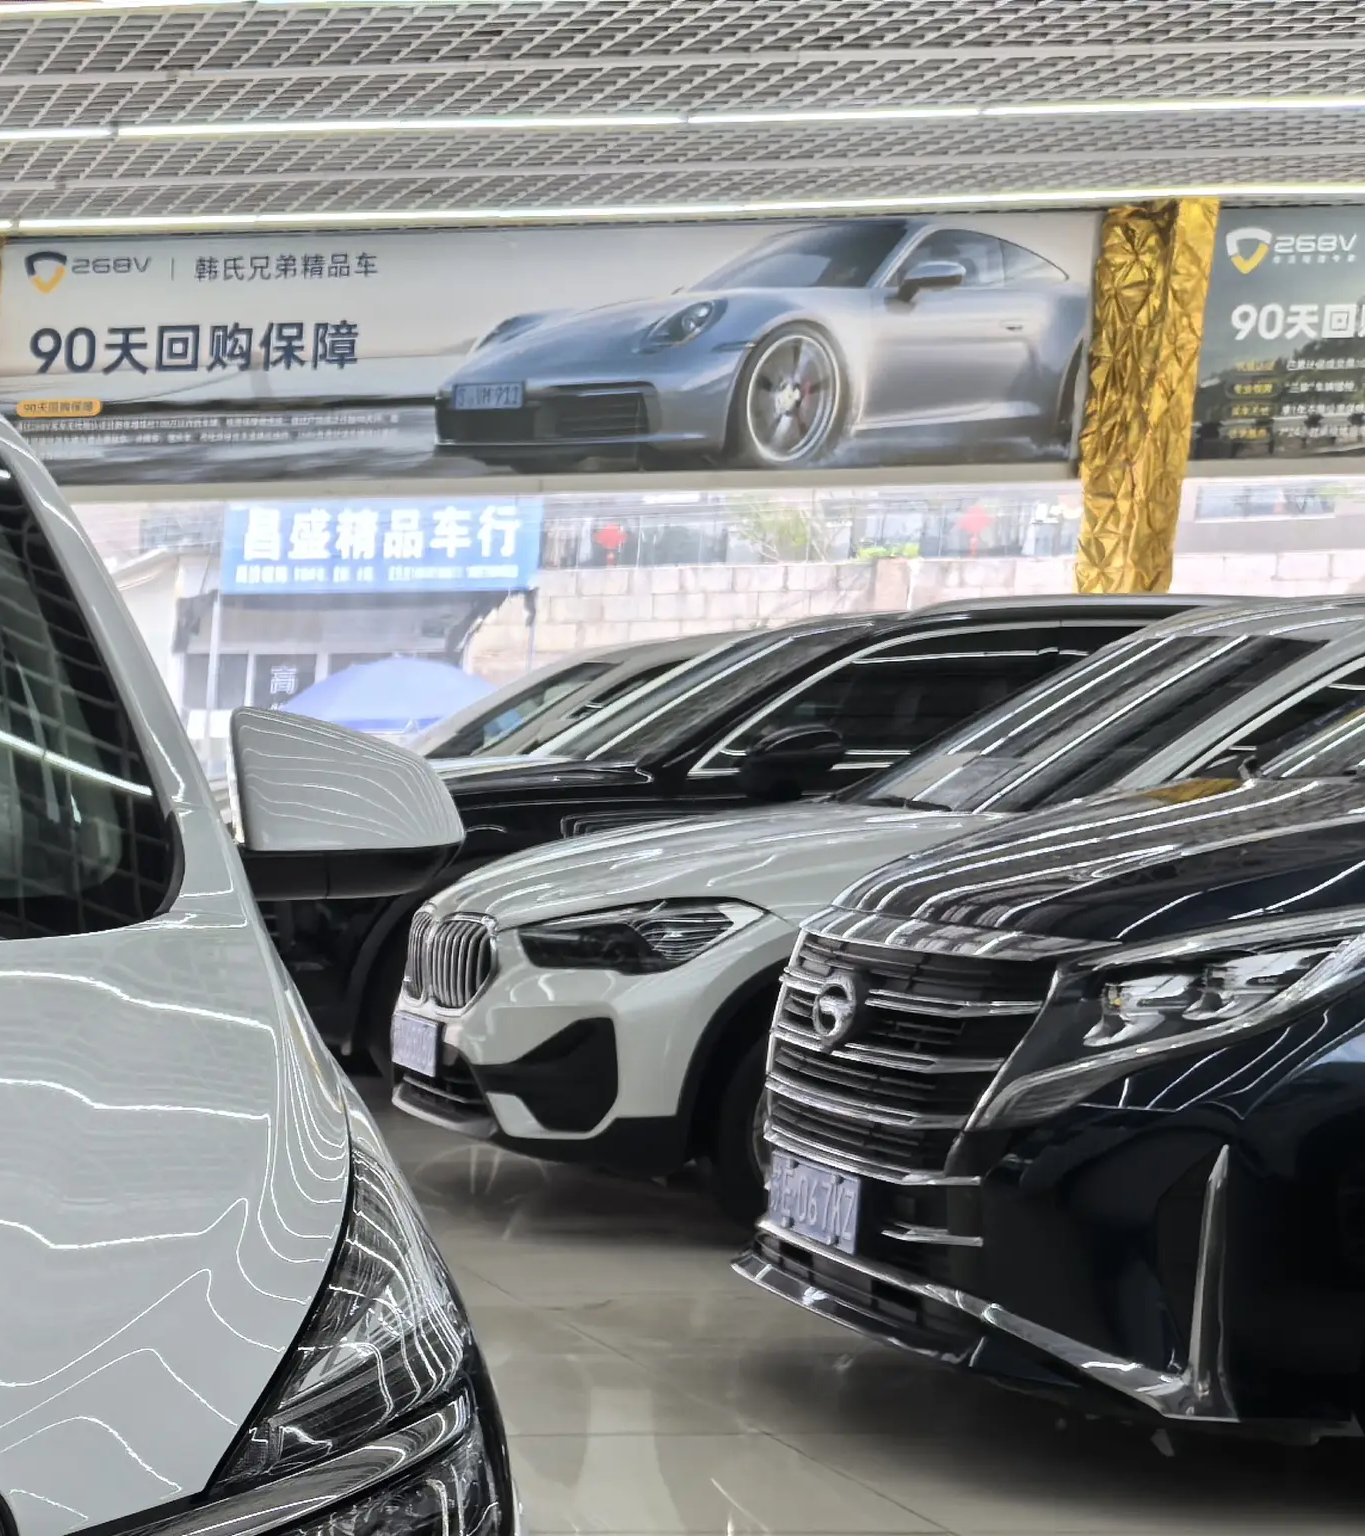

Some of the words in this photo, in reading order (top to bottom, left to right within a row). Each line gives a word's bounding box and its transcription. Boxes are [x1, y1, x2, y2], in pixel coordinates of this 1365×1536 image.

[1273, 233, 1358, 254] 268V
[71, 256, 152, 275] 268V
[193, 251, 379, 282] 韩氏兄弟精品车
[1230, 303, 1365, 341] 90天回
[29, 318, 360, 376] 90天回购保障
[242, 505, 520, 561] 昌盛精品车行
